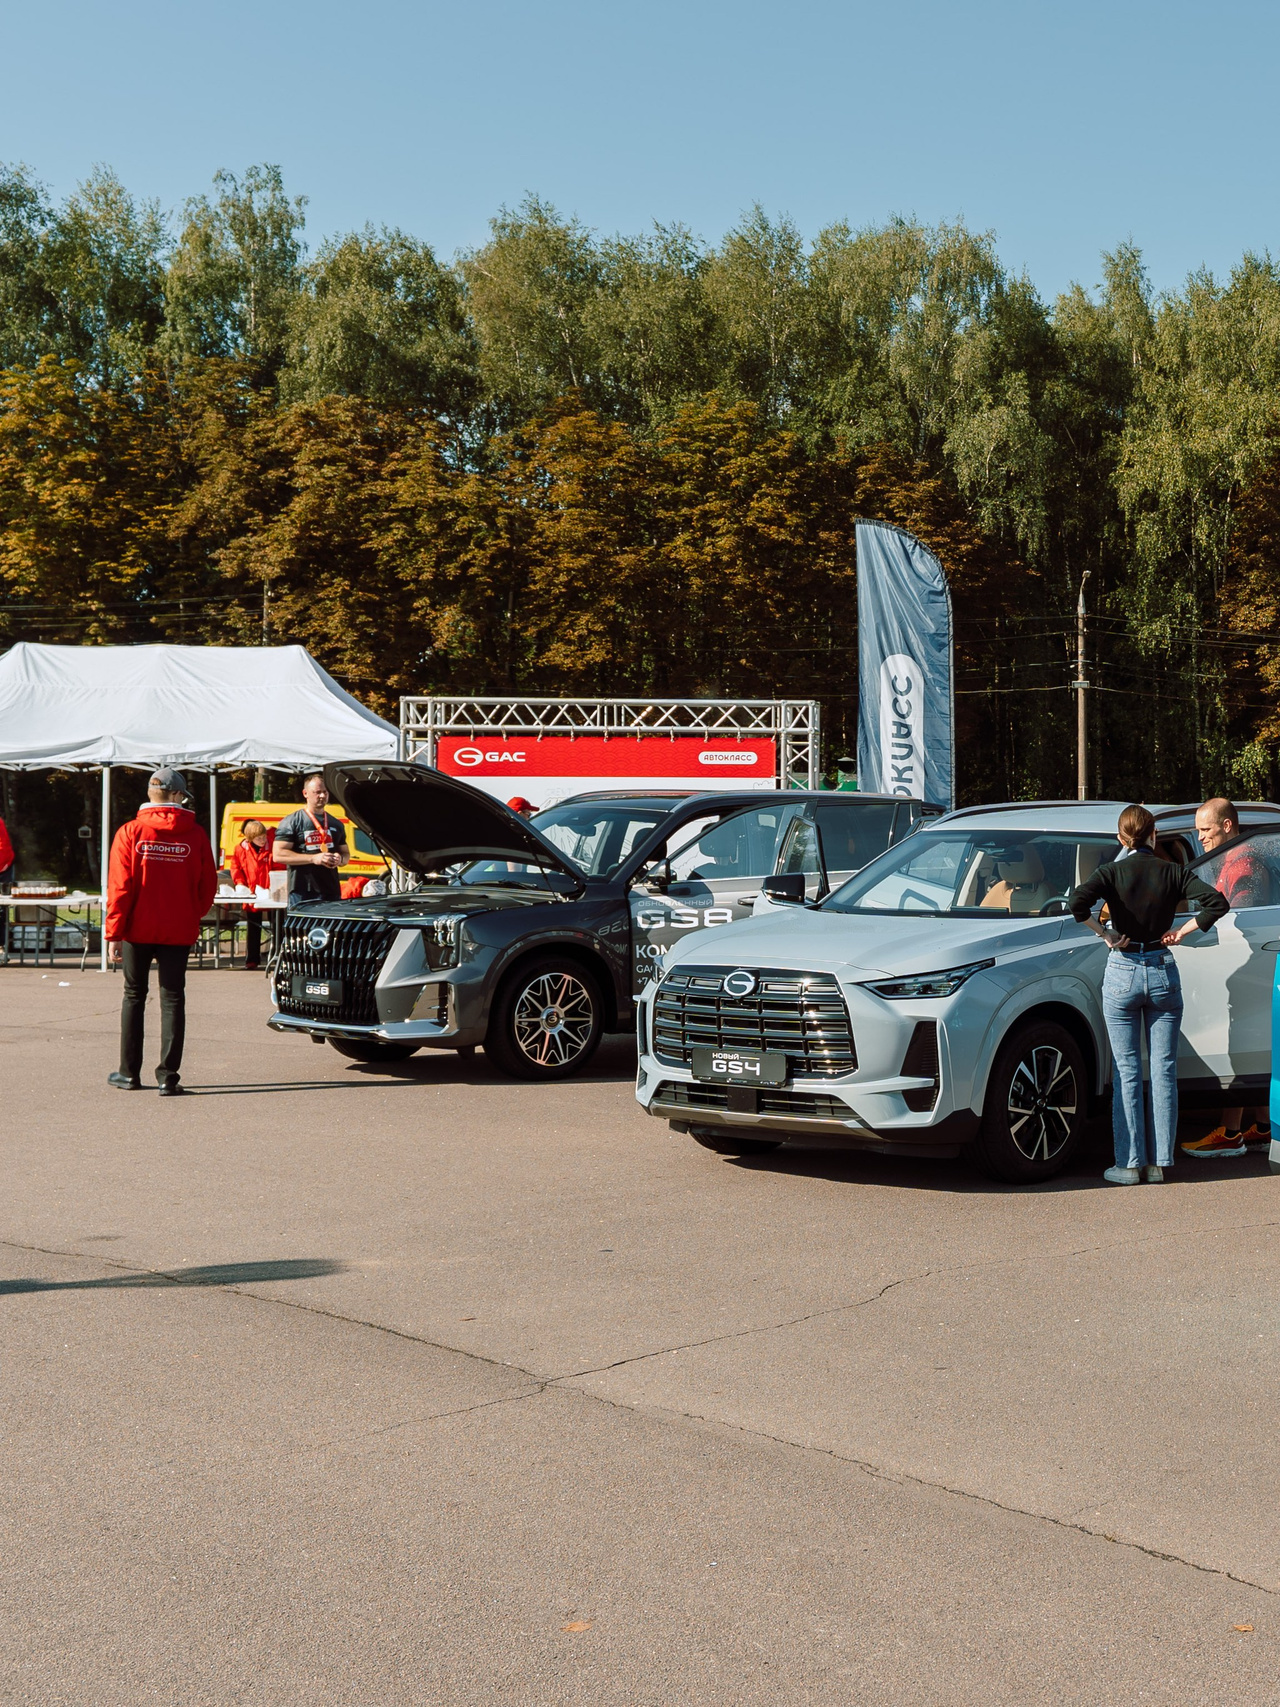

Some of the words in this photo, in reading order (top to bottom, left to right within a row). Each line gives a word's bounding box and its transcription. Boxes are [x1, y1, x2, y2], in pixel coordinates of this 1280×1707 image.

[485, 751, 526, 762] GAC
[703, 754, 752, 762] АВТОКЛАСС
[637, 908, 733, 929] GS8
[636, 965, 653, 973] GA
[305, 985, 329, 996] GS8
[712, 1060, 760, 1076] GS4
